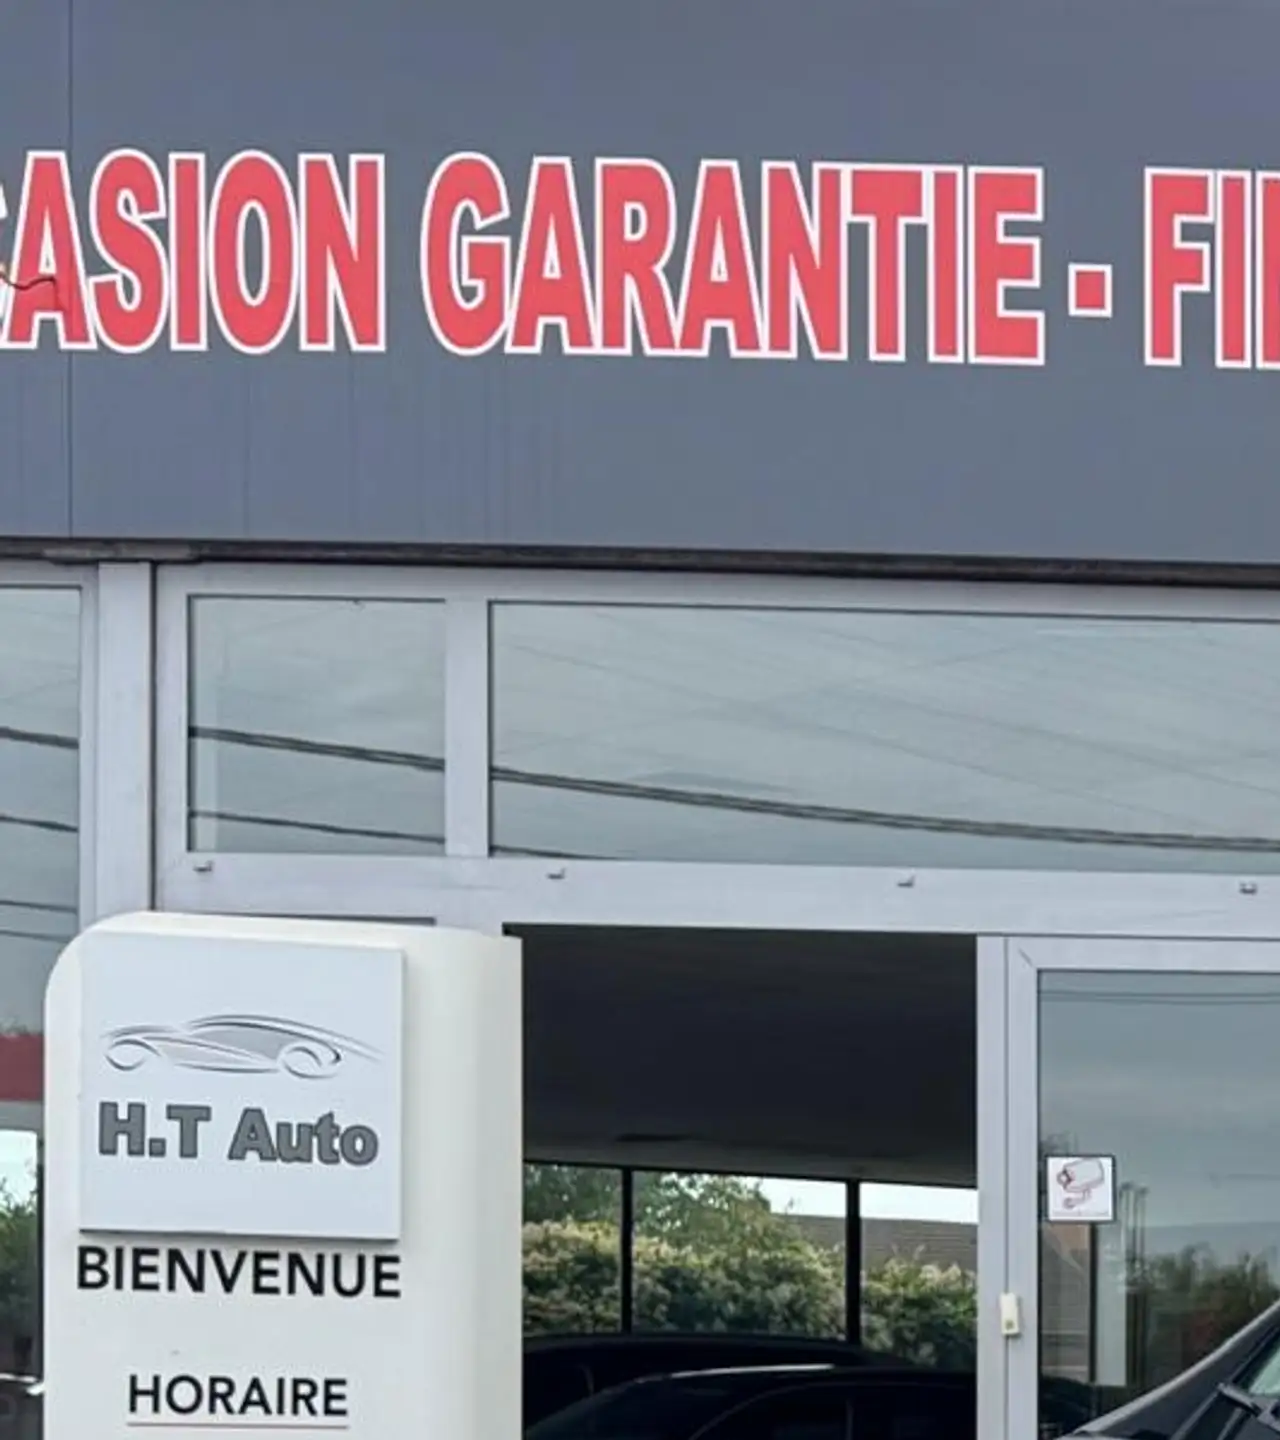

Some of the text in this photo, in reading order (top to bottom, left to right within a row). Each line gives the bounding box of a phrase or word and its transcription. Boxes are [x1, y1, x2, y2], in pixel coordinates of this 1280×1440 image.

[0, 149, 386, 354] ASION
[420, 150, 1046, 365] GARANTIE
[98, 1101, 379, 1166] H.T Auto
[77, 1245, 401, 1298] BIENVENUE
[128, 1373, 348, 1417] HORAIRE
